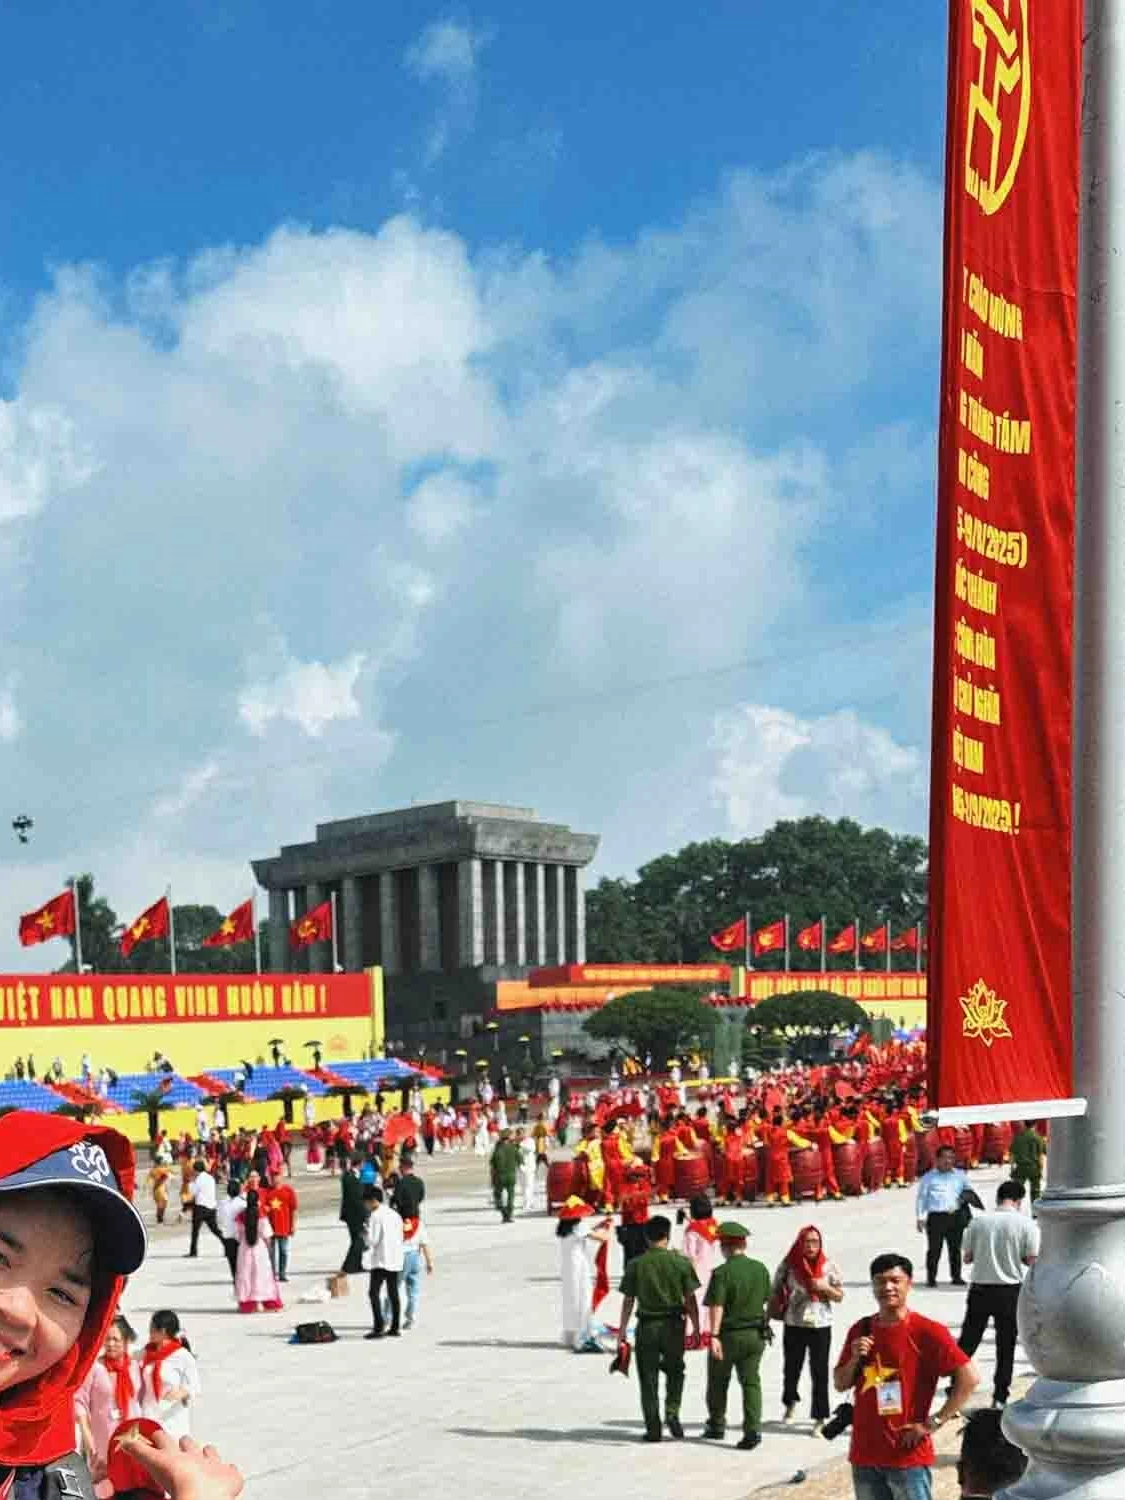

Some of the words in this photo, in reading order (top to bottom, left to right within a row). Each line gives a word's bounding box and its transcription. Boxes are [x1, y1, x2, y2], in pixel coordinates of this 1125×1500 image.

[996, 410, 1032, 455] TÁM
[50, 985, 94, 1019] NAM
[103, 985, 167, 1021] QUANG
[174, 985, 219, 1016] VINH
[226, 980, 274, 1016] MUÔN
